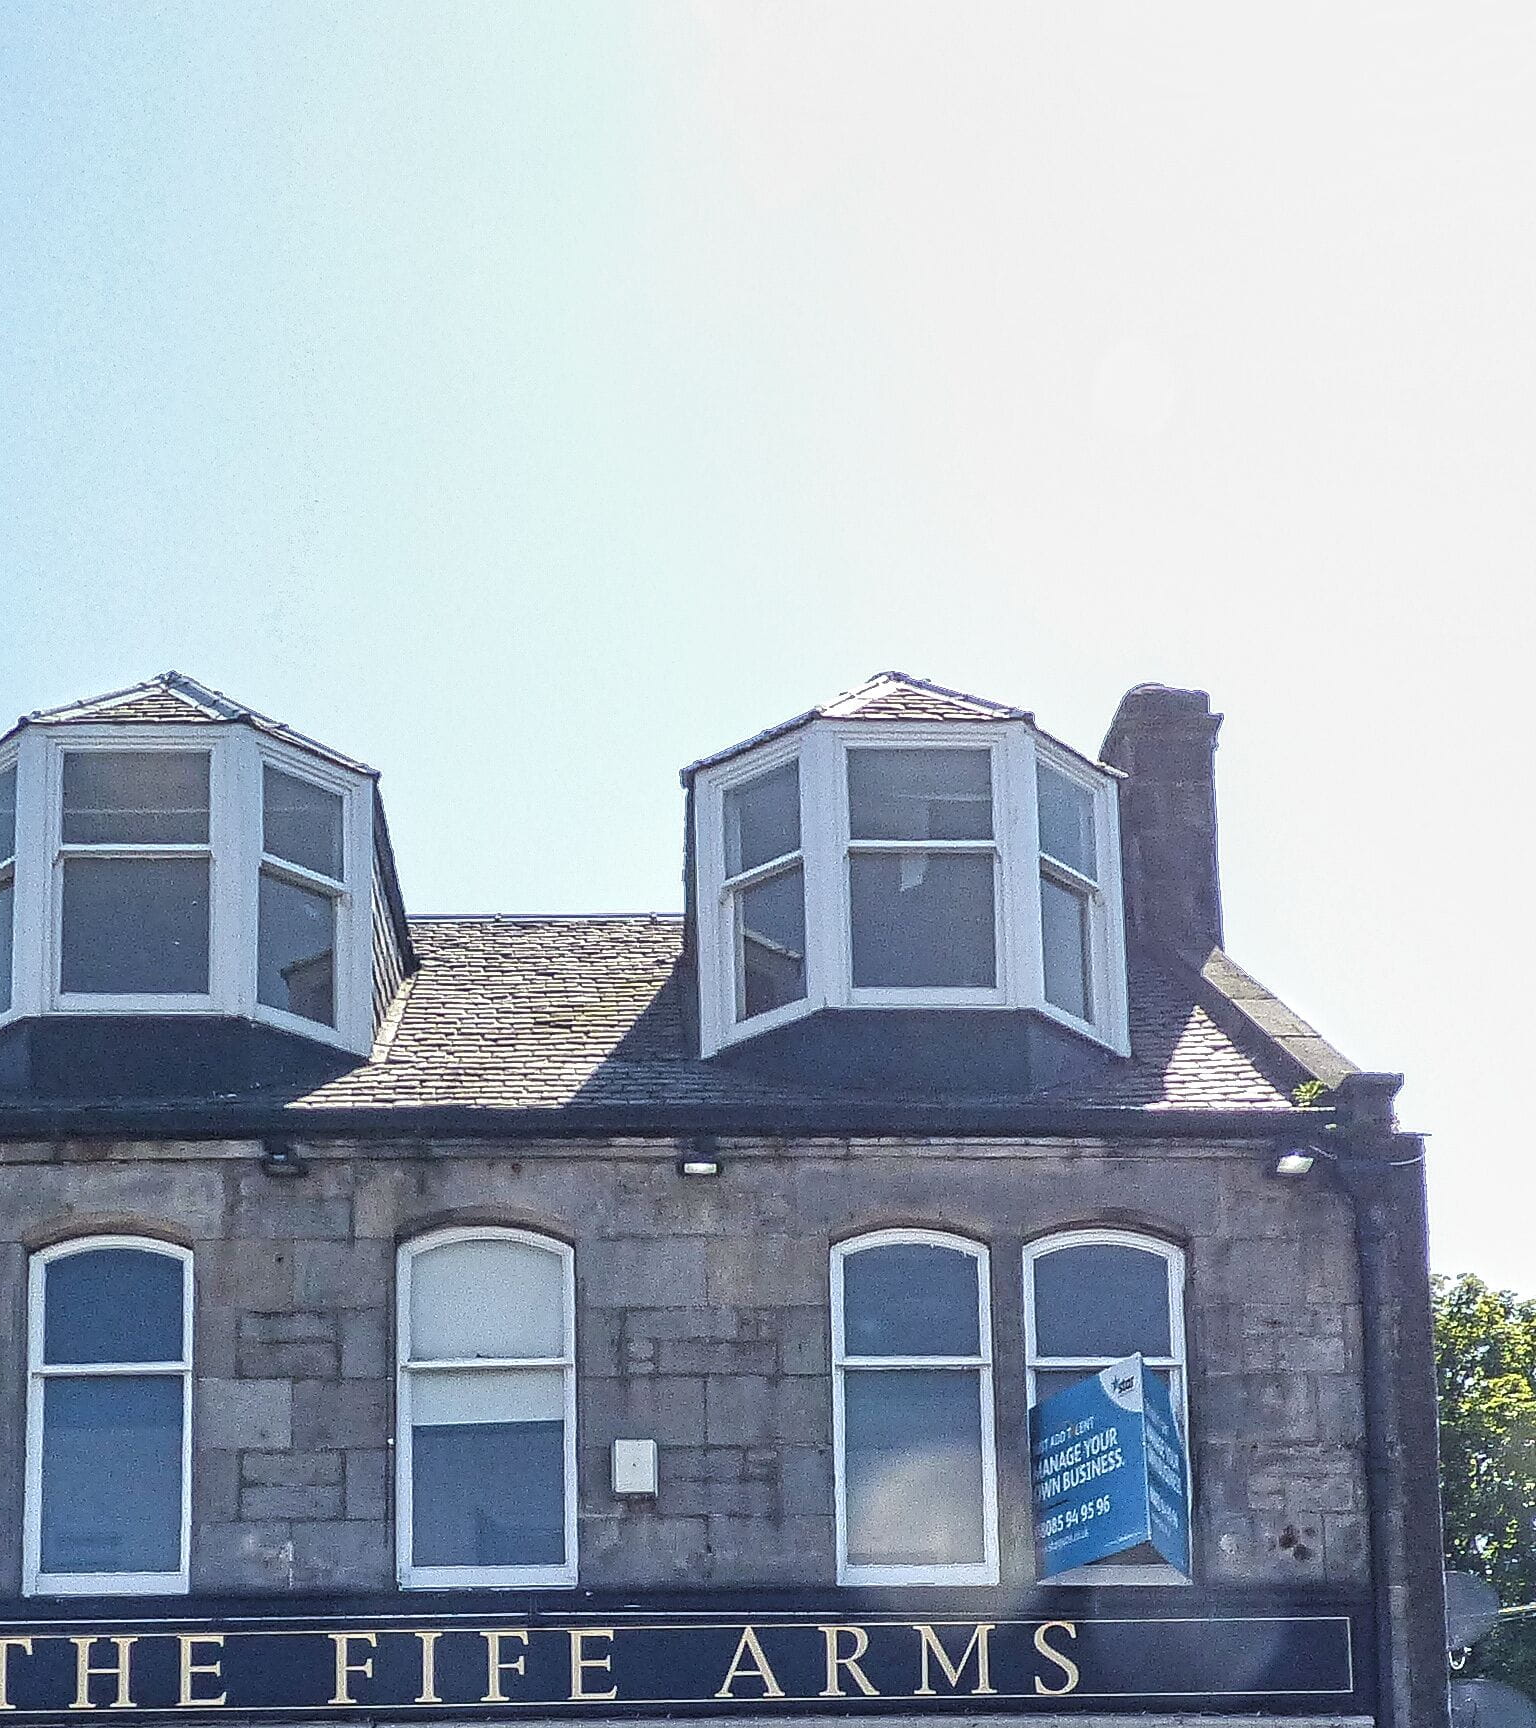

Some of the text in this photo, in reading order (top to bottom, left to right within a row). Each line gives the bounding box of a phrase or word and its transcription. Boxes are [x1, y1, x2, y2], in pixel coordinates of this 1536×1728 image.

[1083, 1427, 1119, 1459] YOUR
[1065, 1508, 1079, 1528] 94
[1080, 1500, 1095, 1522] 95
[1096, 1494, 1111, 1516] 96
[327, 1628, 618, 1704] FIFE
[713, 1620, 1081, 1698] ARMS
